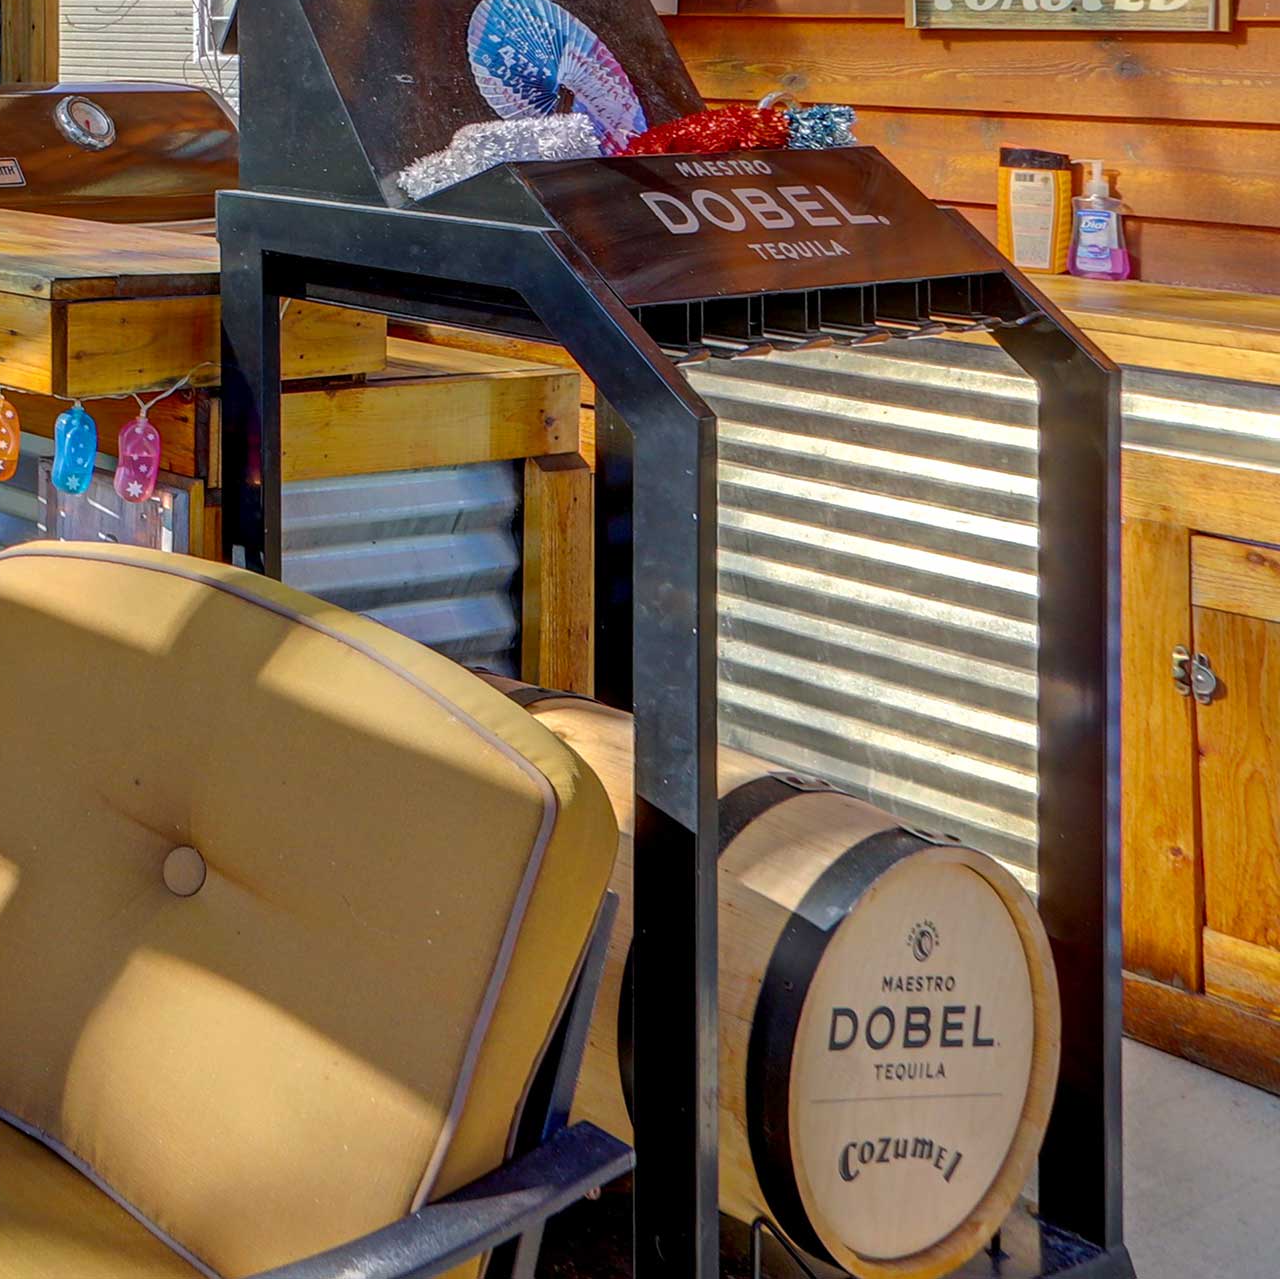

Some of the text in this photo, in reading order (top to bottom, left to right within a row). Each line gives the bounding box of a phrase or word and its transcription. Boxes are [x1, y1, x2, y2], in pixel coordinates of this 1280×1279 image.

[674, 159, 773, 178] MAESTRO
[1080, 219, 1108, 231] Dial
[748, 239, 851, 261] TEQUILA
[881, 975, 957, 993] MAESTRO
[874, 1063, 947, 1081] TEQUILA
